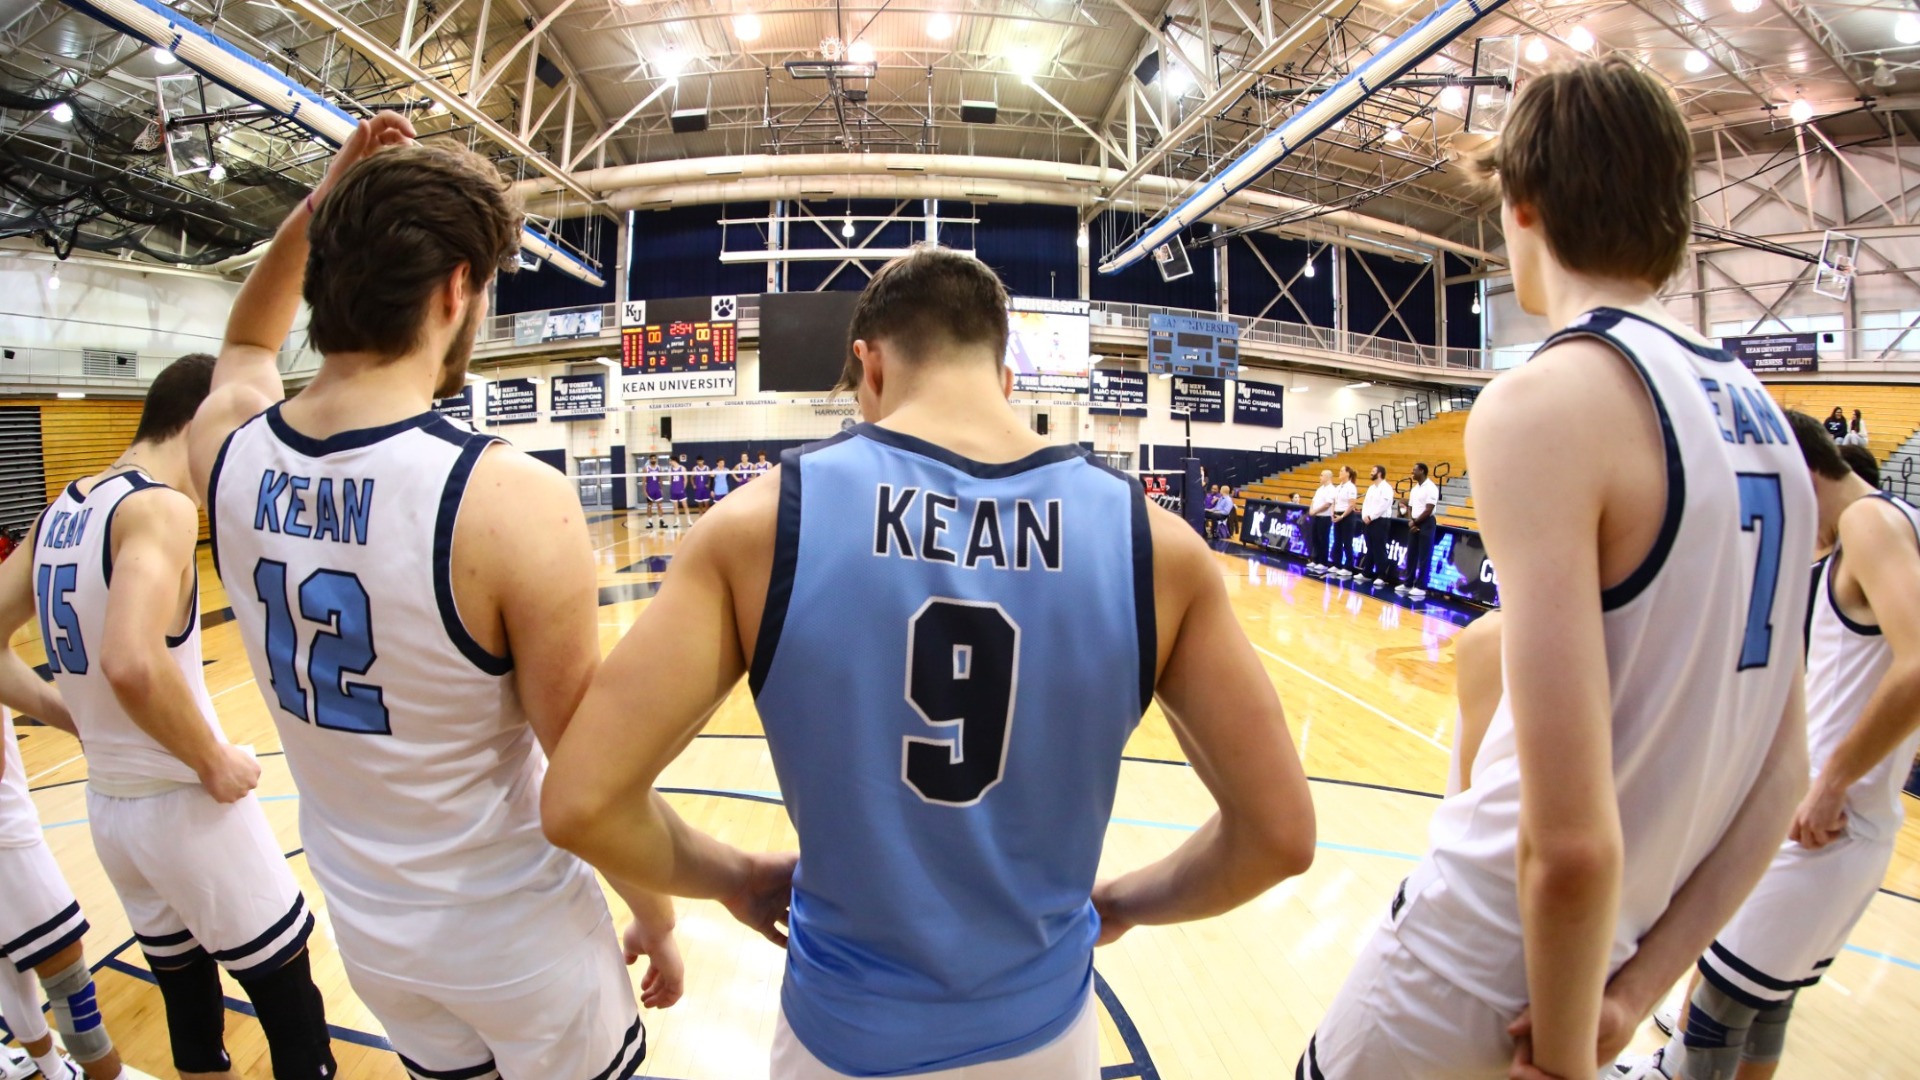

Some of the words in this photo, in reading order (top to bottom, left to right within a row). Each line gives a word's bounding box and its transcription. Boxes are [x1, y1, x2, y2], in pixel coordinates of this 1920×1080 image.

[626, 304, 642, 322] KU
[669, 323, 693, 335] 2:54
[696, 328, 711, 341] 00
[648, 331, 662, 344] 00
[649, 356, 657, 366] 0
[688, 354, 696, 364] 2
[701, 354, 709, 364] 0
[1786, 357, 1813, 365] CIVILITY
[554, 379, 569, 395] KU
[622, 381, 655, 393] KEAN
[659, 377, 734, 391] UNIVERSITY
[1109, 376, 1144, 385] VOLLEYBALL
[1174, 377, 1189, 395] KU
[569, 393, 602, 401] CHAMPIONS
[1110, 388, 1144, 397] CHAMPIONS
[1189, 389, 1222, 397] VOLLEYBALL
[1238, 382, 1251, 399] KU
[1251, 388, 1276, 397] FOOTBALL
[502, 397, 534, 405] CHAMPIONS
[1252, 399, 1281, 409] CHAMPIONS
[815, 408, 855, 416] HARWOOD
[1700, 377, 1790, 446] EAN
[254, 469, 375, 546] KEAN
[43, 507, 94, 550] KEAN
[872, 482, 1063, 573] KEAN
[1268, 517, 1293, 538] Kean
[1736, 471, 1785, 672] 7
[37, 563, 88, 675] 15
[253, 557, 392, 736] 12
[901, 595, 1022, 808] 9
